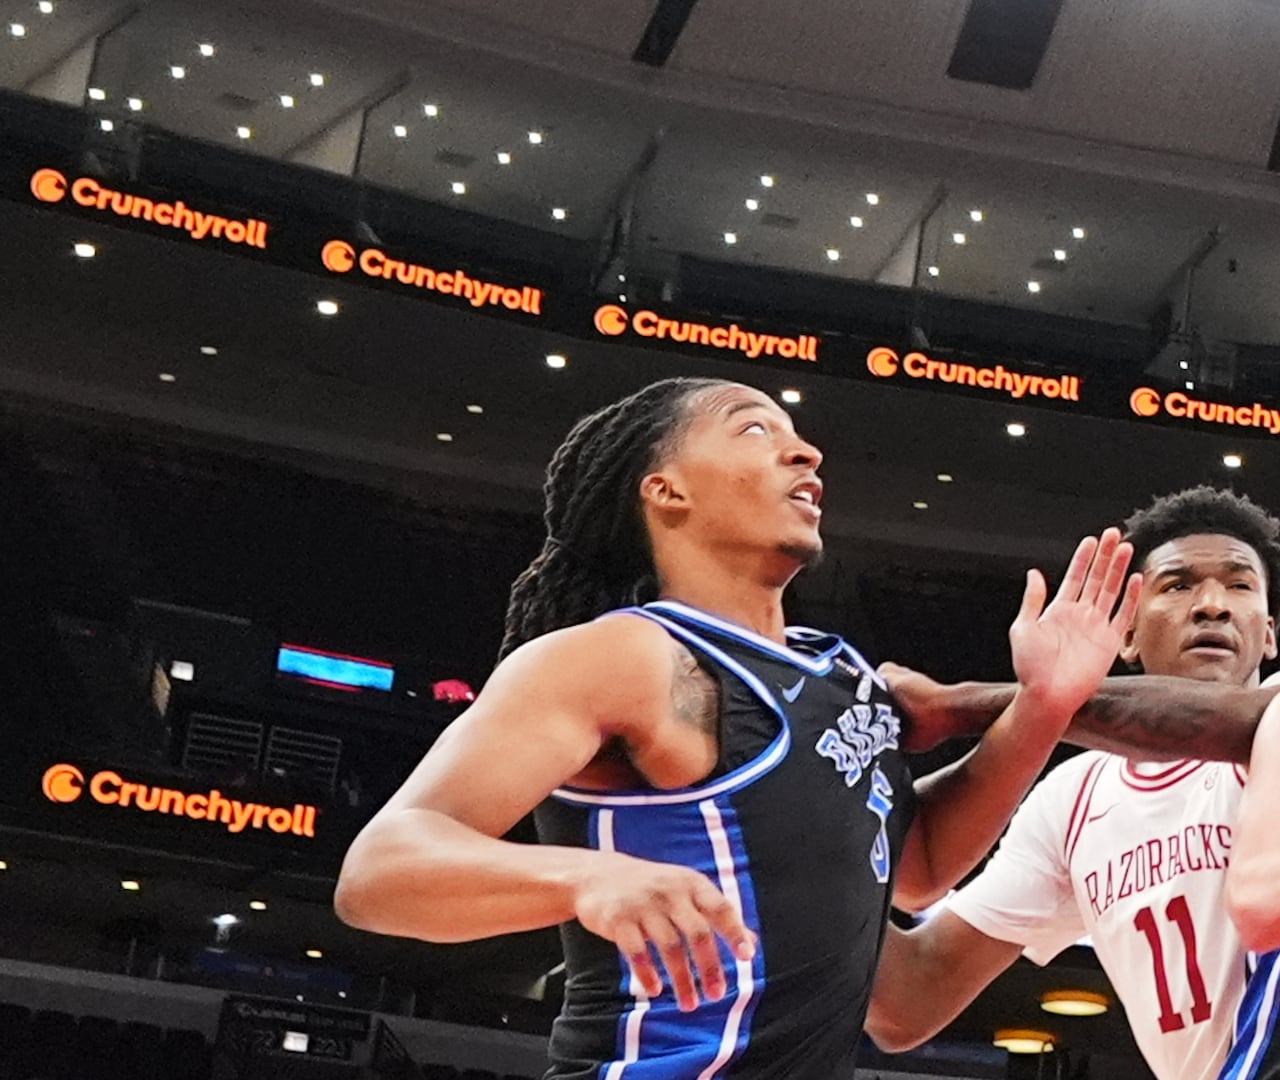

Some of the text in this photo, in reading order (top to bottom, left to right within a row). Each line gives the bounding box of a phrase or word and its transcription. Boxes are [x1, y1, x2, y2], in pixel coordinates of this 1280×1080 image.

[72, 177, 267, 249] Crunchyroll
[360, 249, 540, 315] Crunchyroll
[633, 311, 817, 361] Crunchyroll
[904, 353, 1079, 401] Crunchyroll
[91, 770, 315, 837] Crunchyroll
[1134, 896, 1211, 1033] 11
